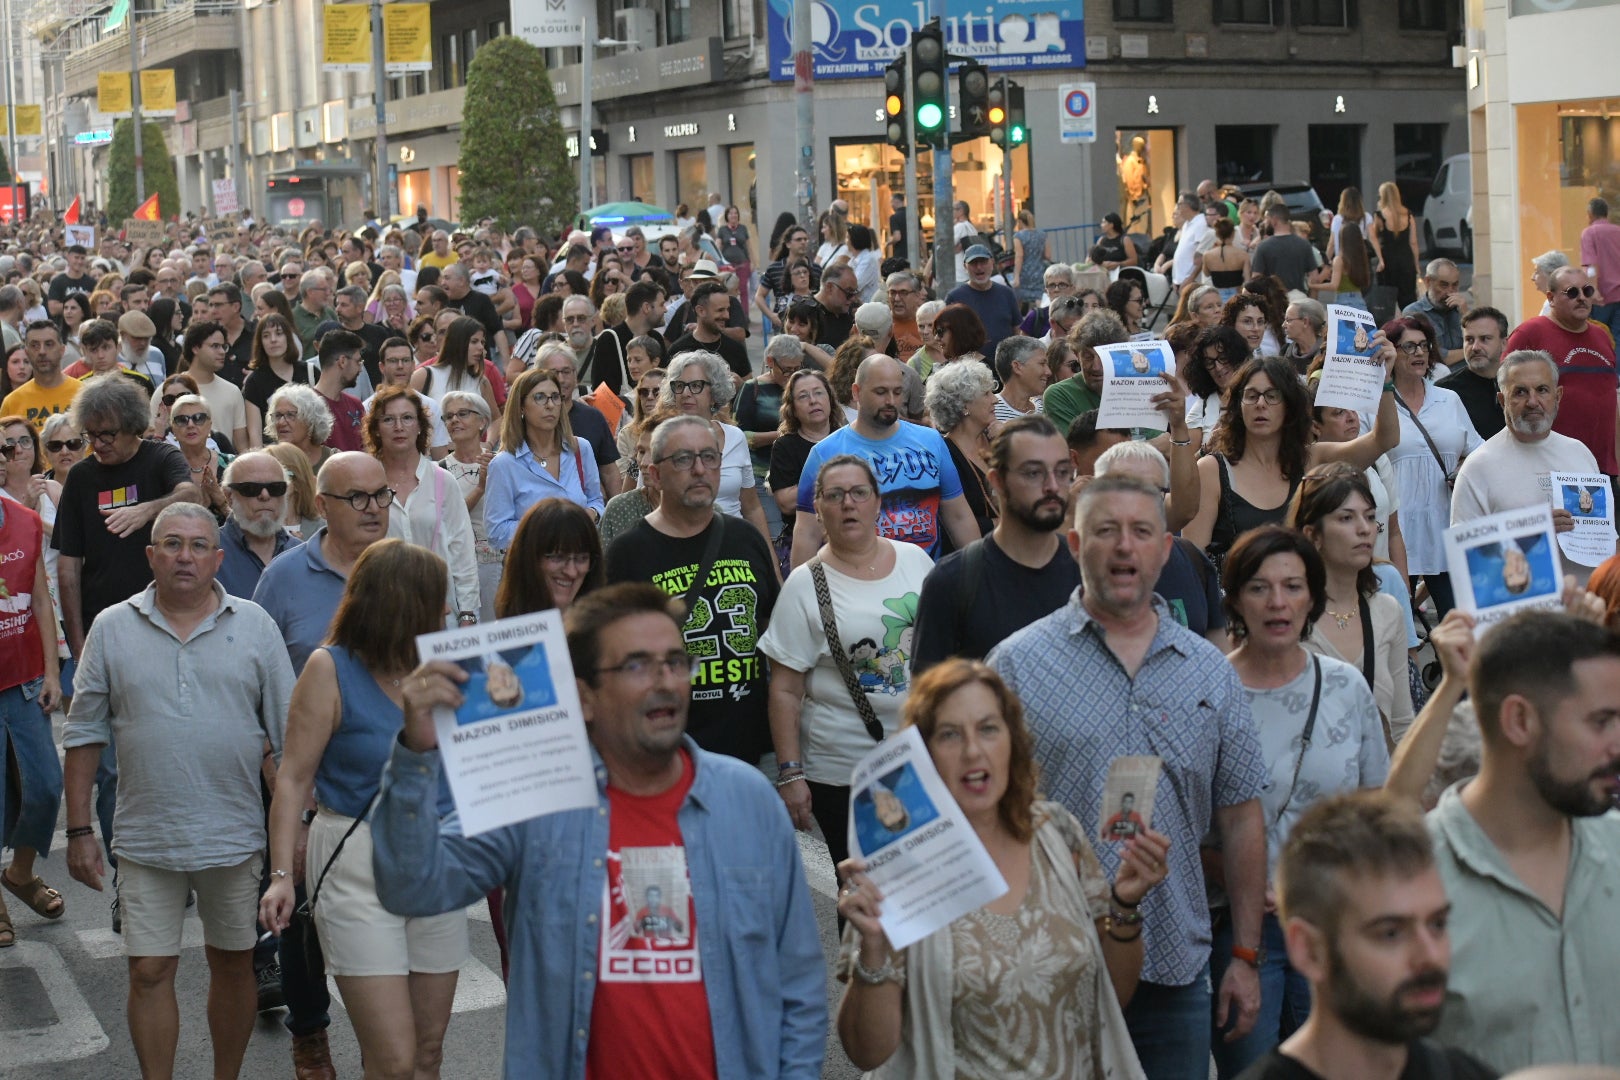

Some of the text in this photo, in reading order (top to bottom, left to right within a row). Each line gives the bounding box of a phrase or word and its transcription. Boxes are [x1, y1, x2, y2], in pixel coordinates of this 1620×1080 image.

[523, 25, 582, 34] MOSQUEIR
[664, 123, 698, 137] SCALPERS
[664, 566, 690, 579] MOTUL
[432, 622, 549, 655] MAZON DIMISION
[694, 691, 721, 699] MOTUL
[452, 710, 569, 744] MAZON DIMISION
[903, 818, 954, 851] DIMISION
[609, 957, 694, 974] CCOO
